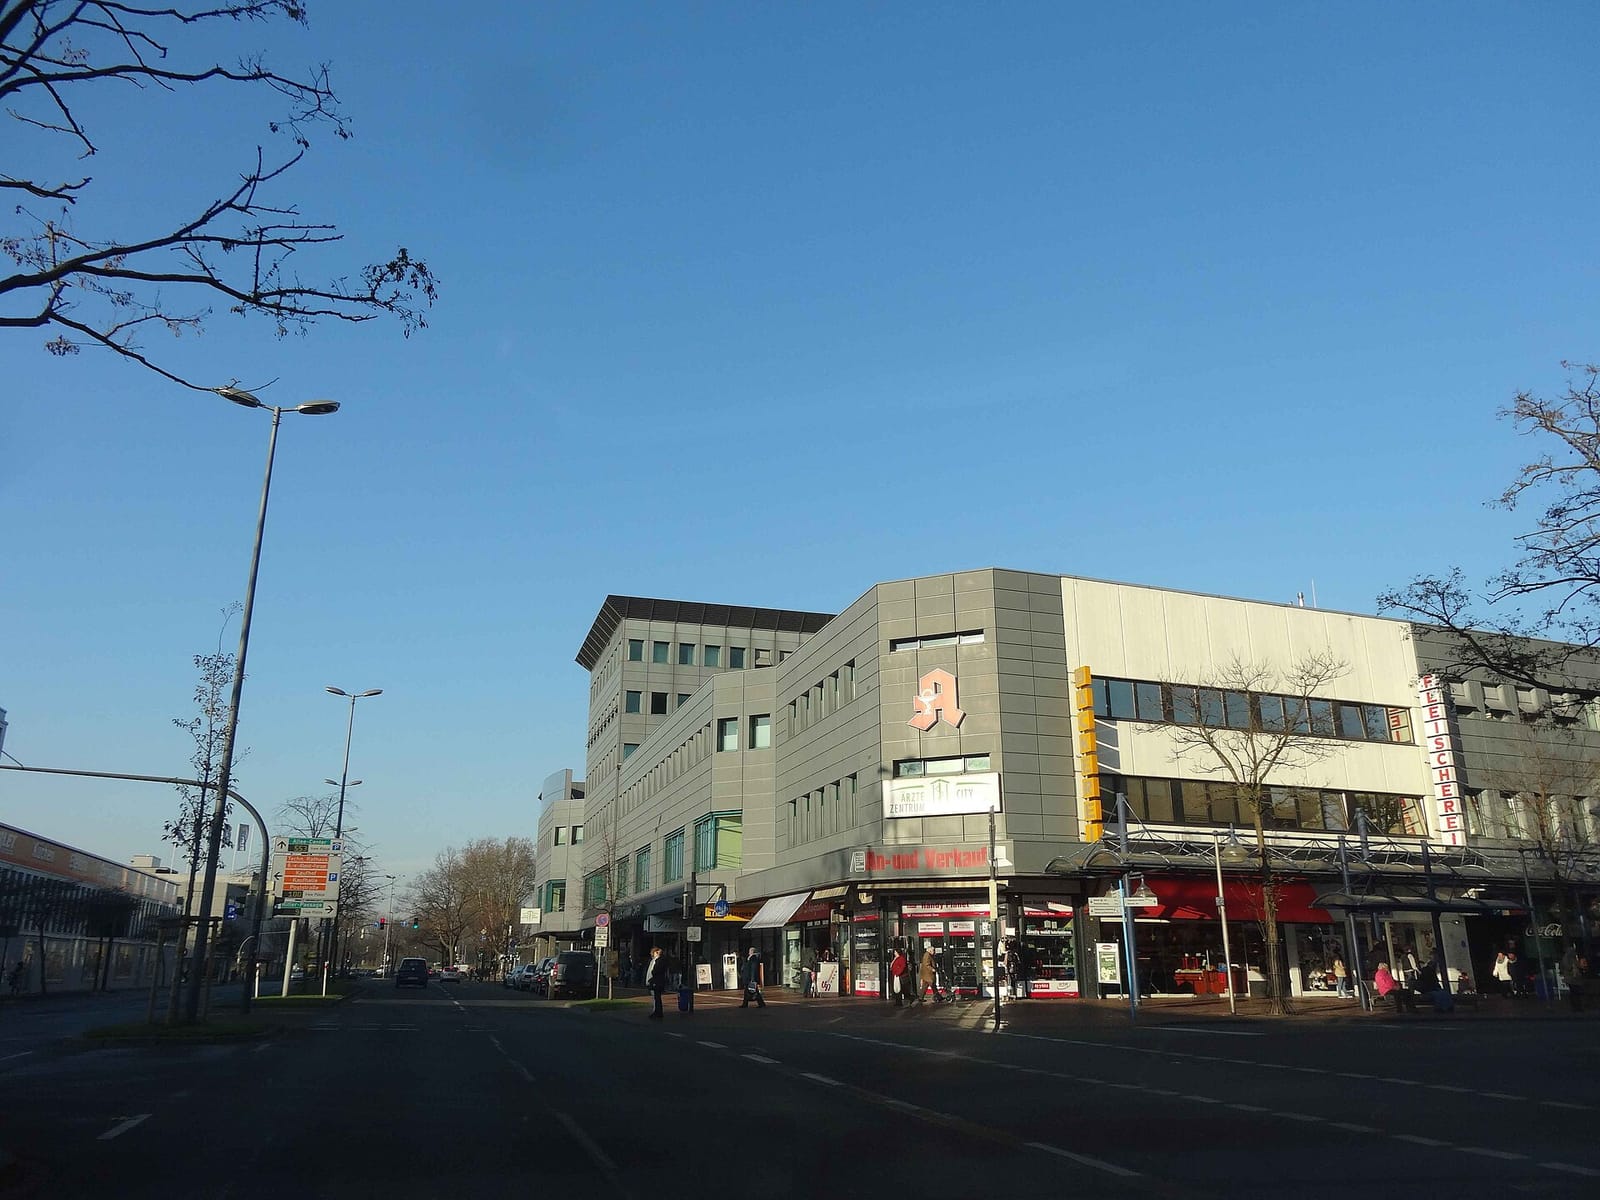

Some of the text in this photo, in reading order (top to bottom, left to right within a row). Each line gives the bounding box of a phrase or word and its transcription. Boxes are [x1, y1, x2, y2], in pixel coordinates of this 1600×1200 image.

[1422, 673, 1458, 845] FLEISCHEREI
[956, 788, 974, 799] CITY
[889, 803, 925, 814] ZENTRUM
[924, 845, 988, 868] Verkauf
